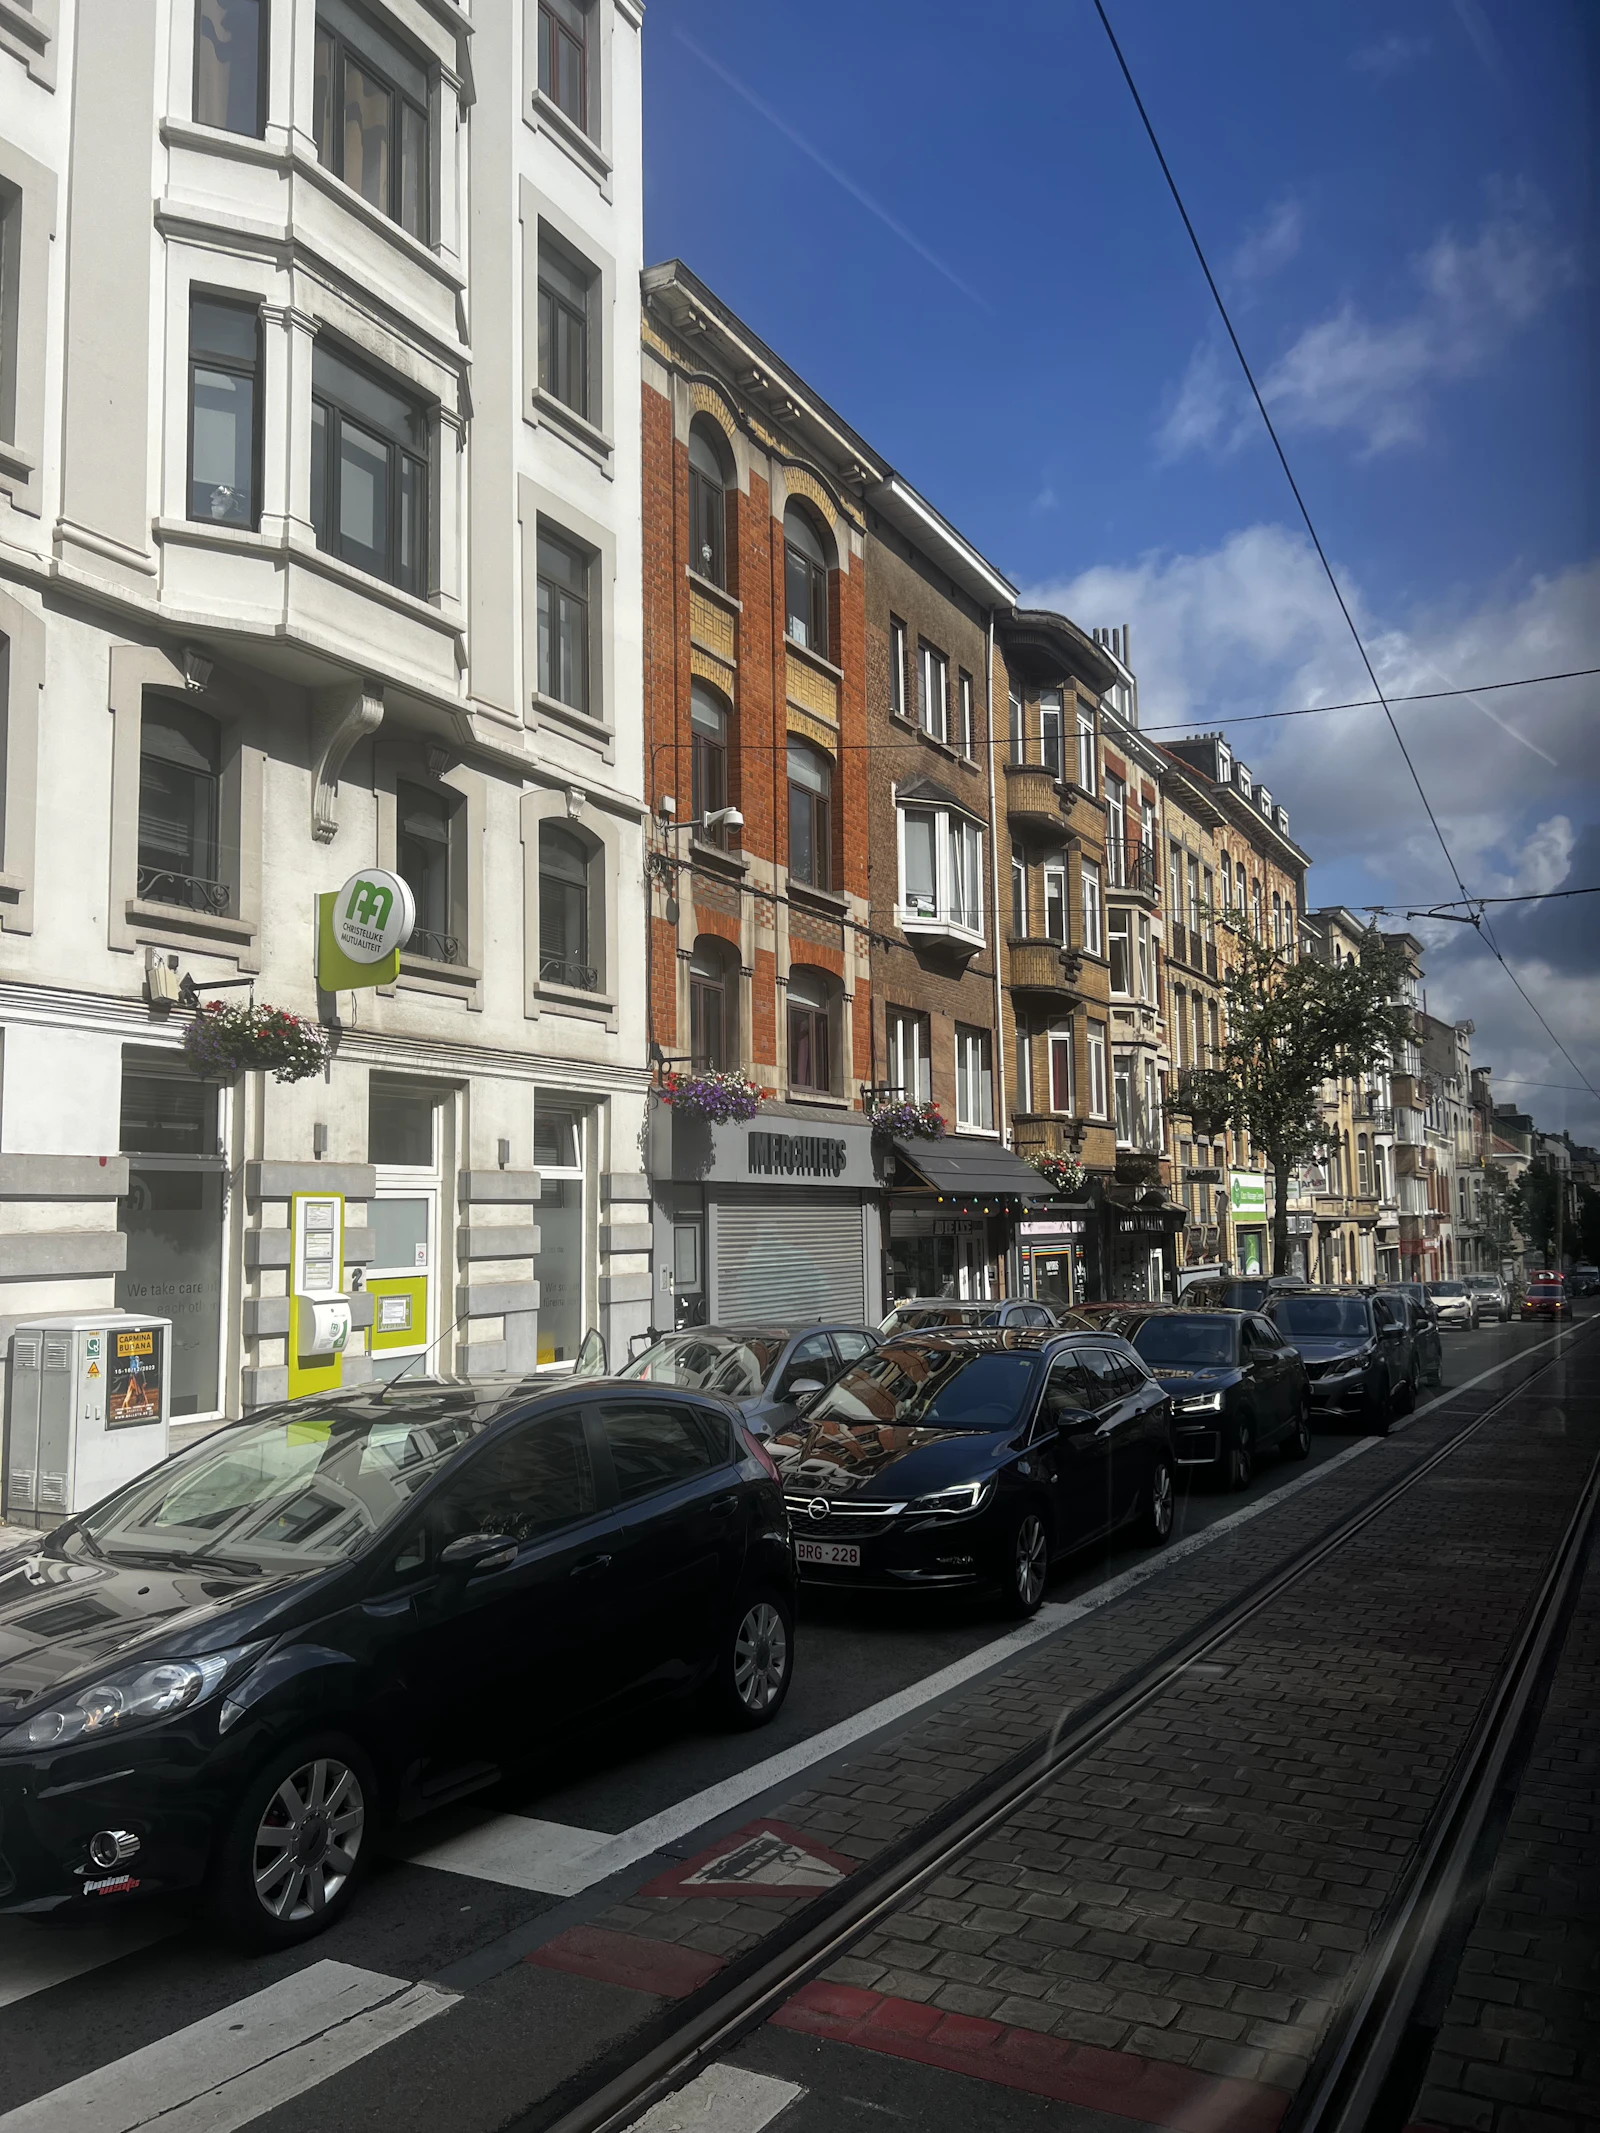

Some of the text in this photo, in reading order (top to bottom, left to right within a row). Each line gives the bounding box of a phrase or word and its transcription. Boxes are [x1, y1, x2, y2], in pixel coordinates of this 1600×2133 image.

[341, 932, 382, 953] MUTUALITEIT
[752, 1132, 847, 1171] MERCHIERS
[127, 1284, 147, 1297] We
[150, 1282, 175, 1296] take
[179, 1283, 203, 1294] care
[119, 1334, 152, 1344] CARMINA
